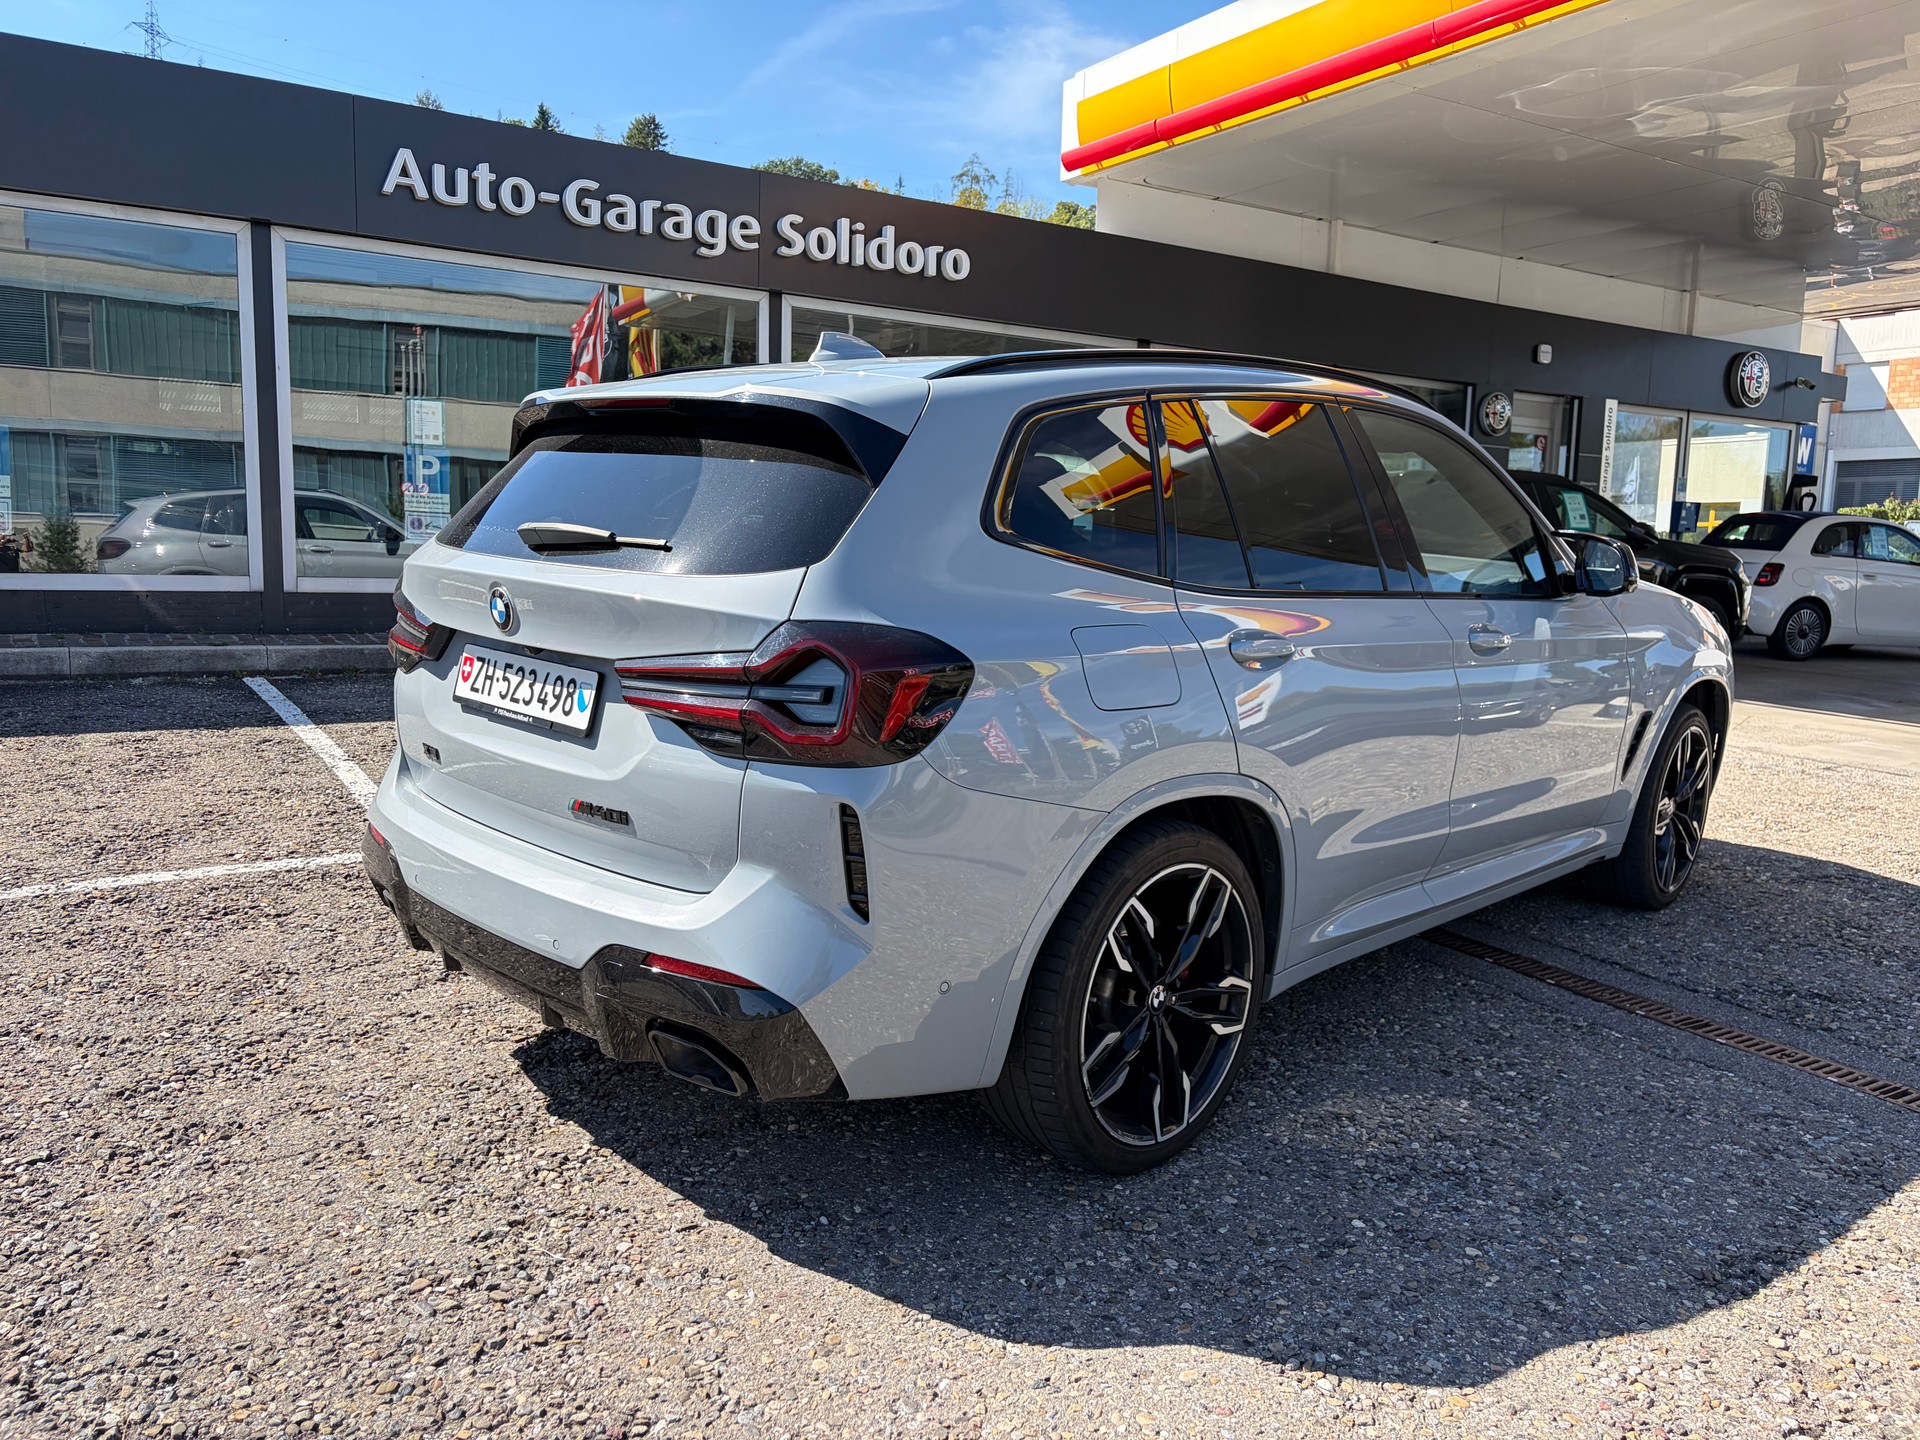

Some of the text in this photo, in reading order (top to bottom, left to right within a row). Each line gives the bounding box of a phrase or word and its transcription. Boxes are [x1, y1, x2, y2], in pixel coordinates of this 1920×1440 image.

[381, 147, 972, 282] Auto-Garage Solidoro
[415, 454, 441, 487] P
